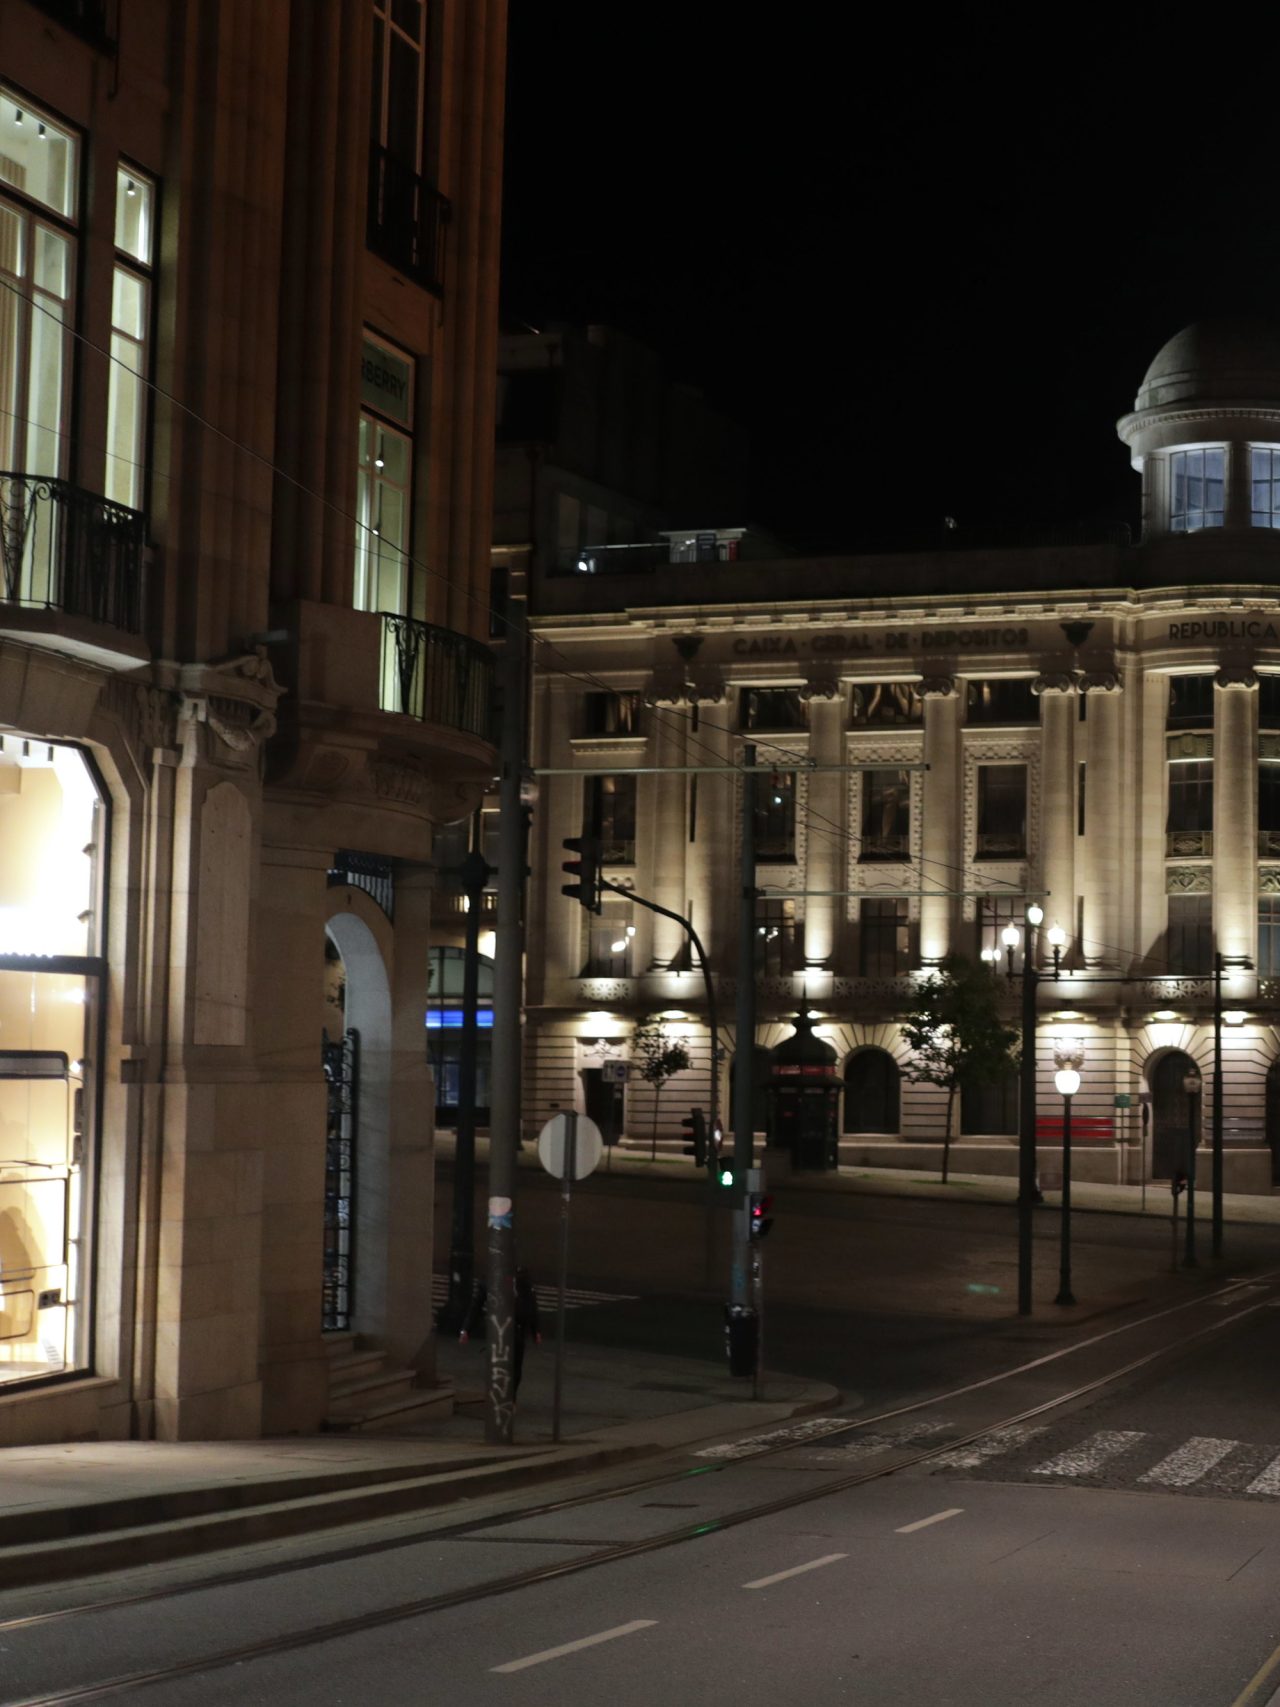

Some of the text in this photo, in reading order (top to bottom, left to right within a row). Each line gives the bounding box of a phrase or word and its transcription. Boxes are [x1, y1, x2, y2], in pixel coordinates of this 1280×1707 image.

[732, 628, 1029, 655] CAIXA GERAL DE DEPOSITOS
[1168, 621, 1278, 641] REPUBLICA
